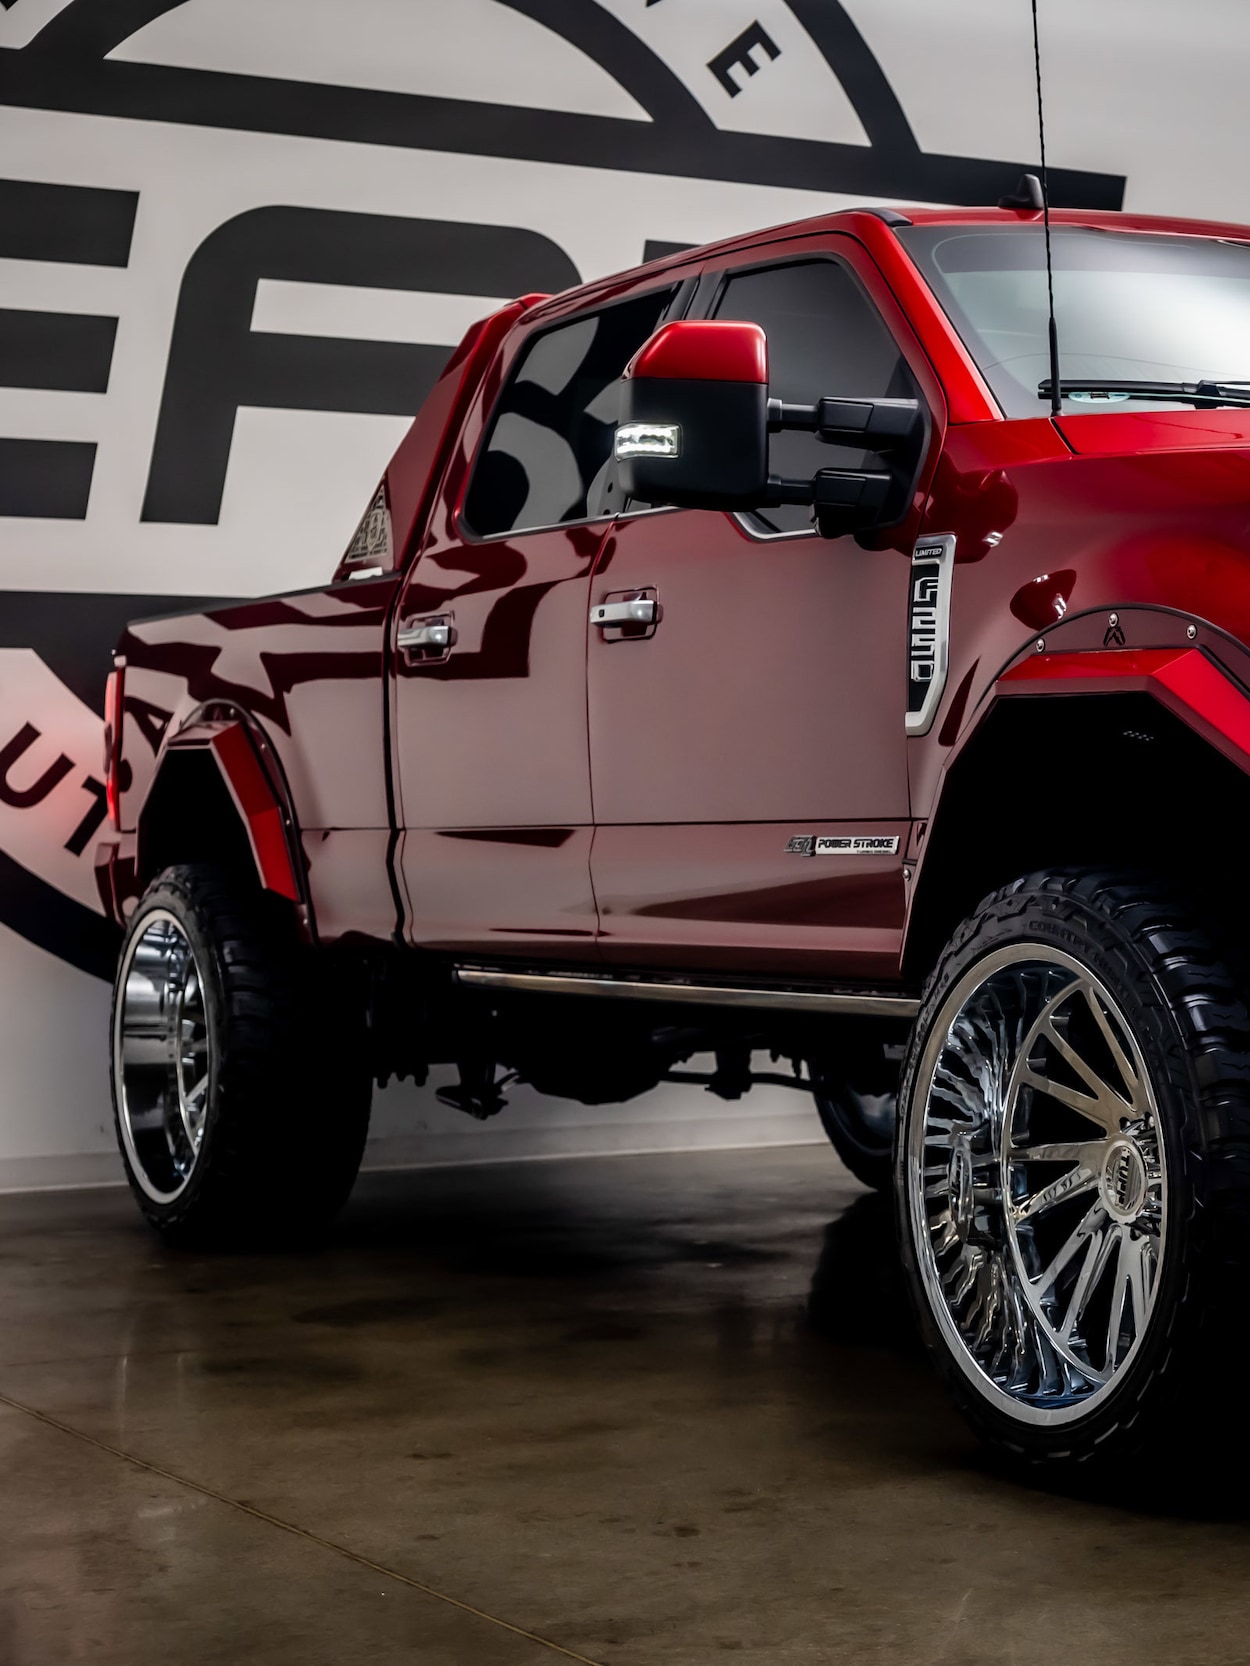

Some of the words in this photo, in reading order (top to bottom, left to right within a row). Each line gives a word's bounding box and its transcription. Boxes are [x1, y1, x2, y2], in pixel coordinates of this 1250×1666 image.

[914, 547, 942, 557] LIMITED
[818, 838, 851, 849] POWER
[853, 838, 894, 849] STROKE
